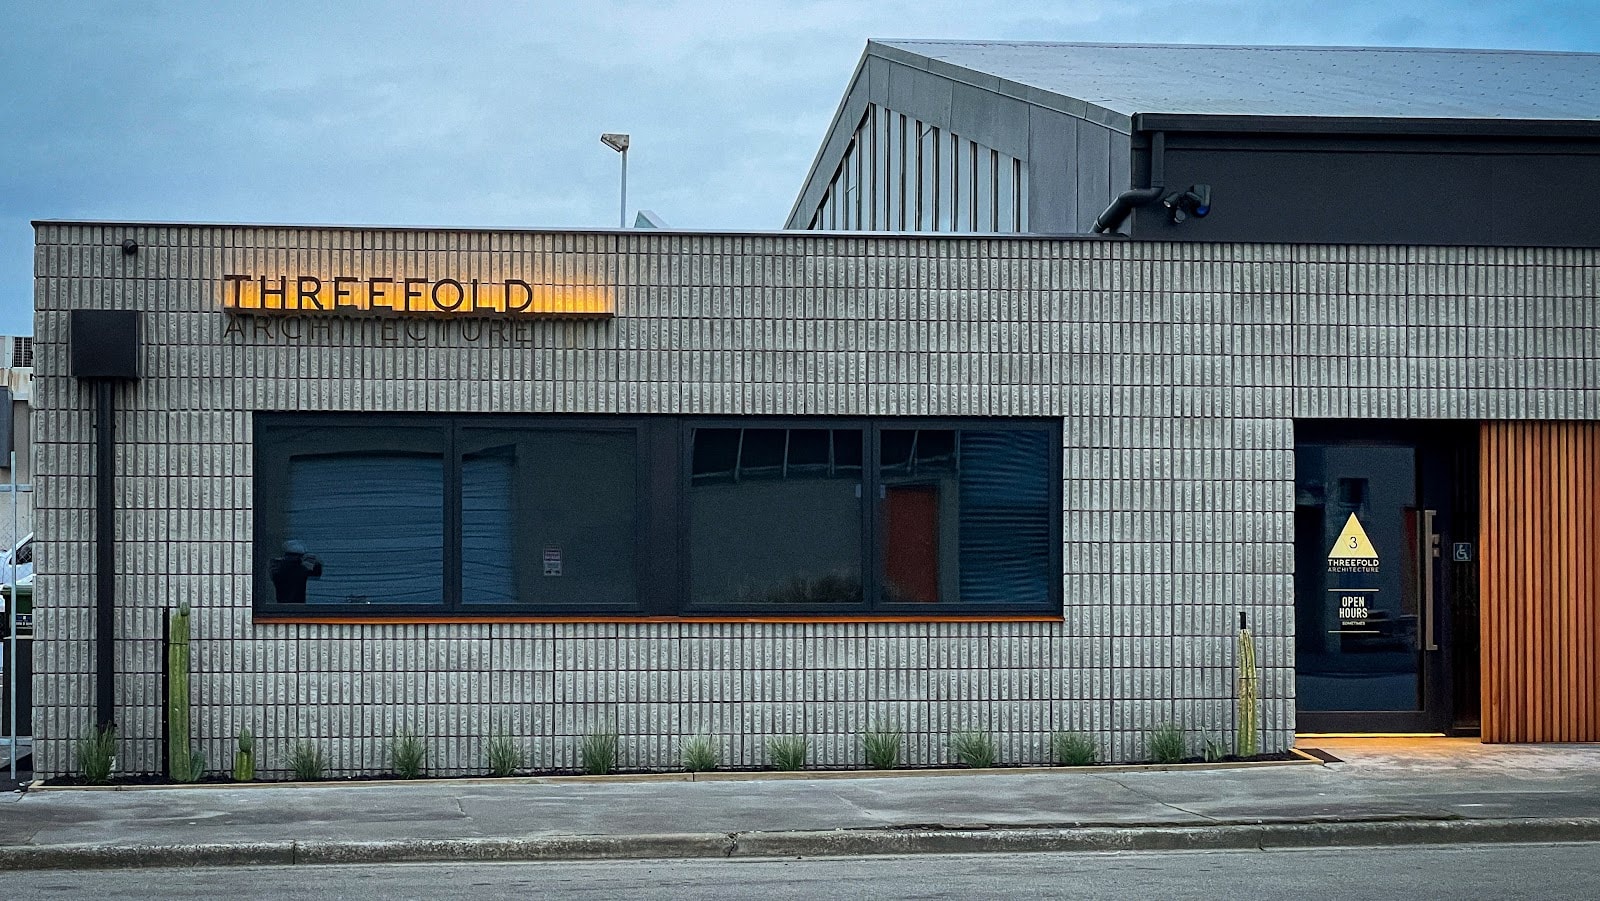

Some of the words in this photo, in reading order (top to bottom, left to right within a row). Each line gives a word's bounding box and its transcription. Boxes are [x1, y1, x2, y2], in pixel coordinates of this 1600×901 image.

[224, 274, 533, 313] THREEFOLD
[224, 313, 533, 342] ARCHITECTURE
[1349, 536, 1358, 549] 3
[1328, 559, 1379, 567] THREEFOLD
[1342, 596, 1365, 607] OPEN
[1339, 607, 1368, 618] HOURS
